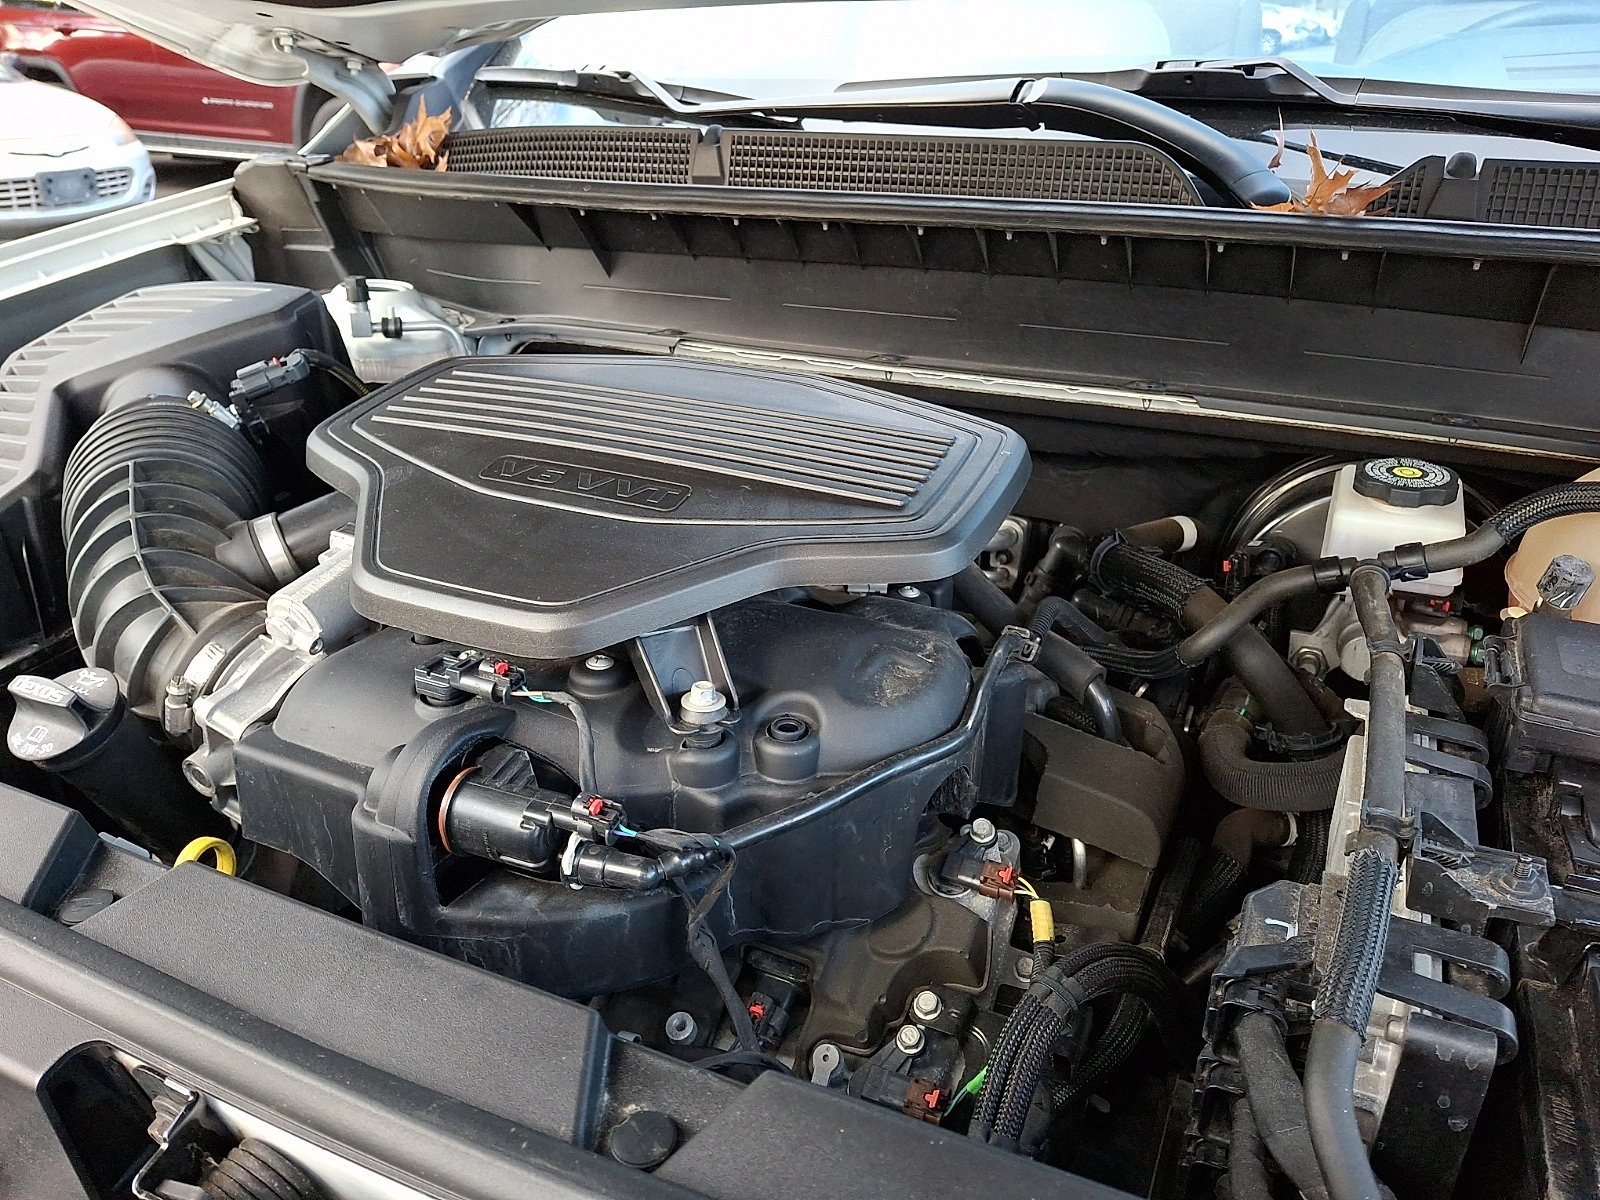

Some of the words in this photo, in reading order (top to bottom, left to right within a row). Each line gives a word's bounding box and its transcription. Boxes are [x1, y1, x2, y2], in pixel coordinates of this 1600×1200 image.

[500, 459, 568, 484] V6
[577, 472, 682, 503] VVT
[20, 742, 54, 755] 5W-30
